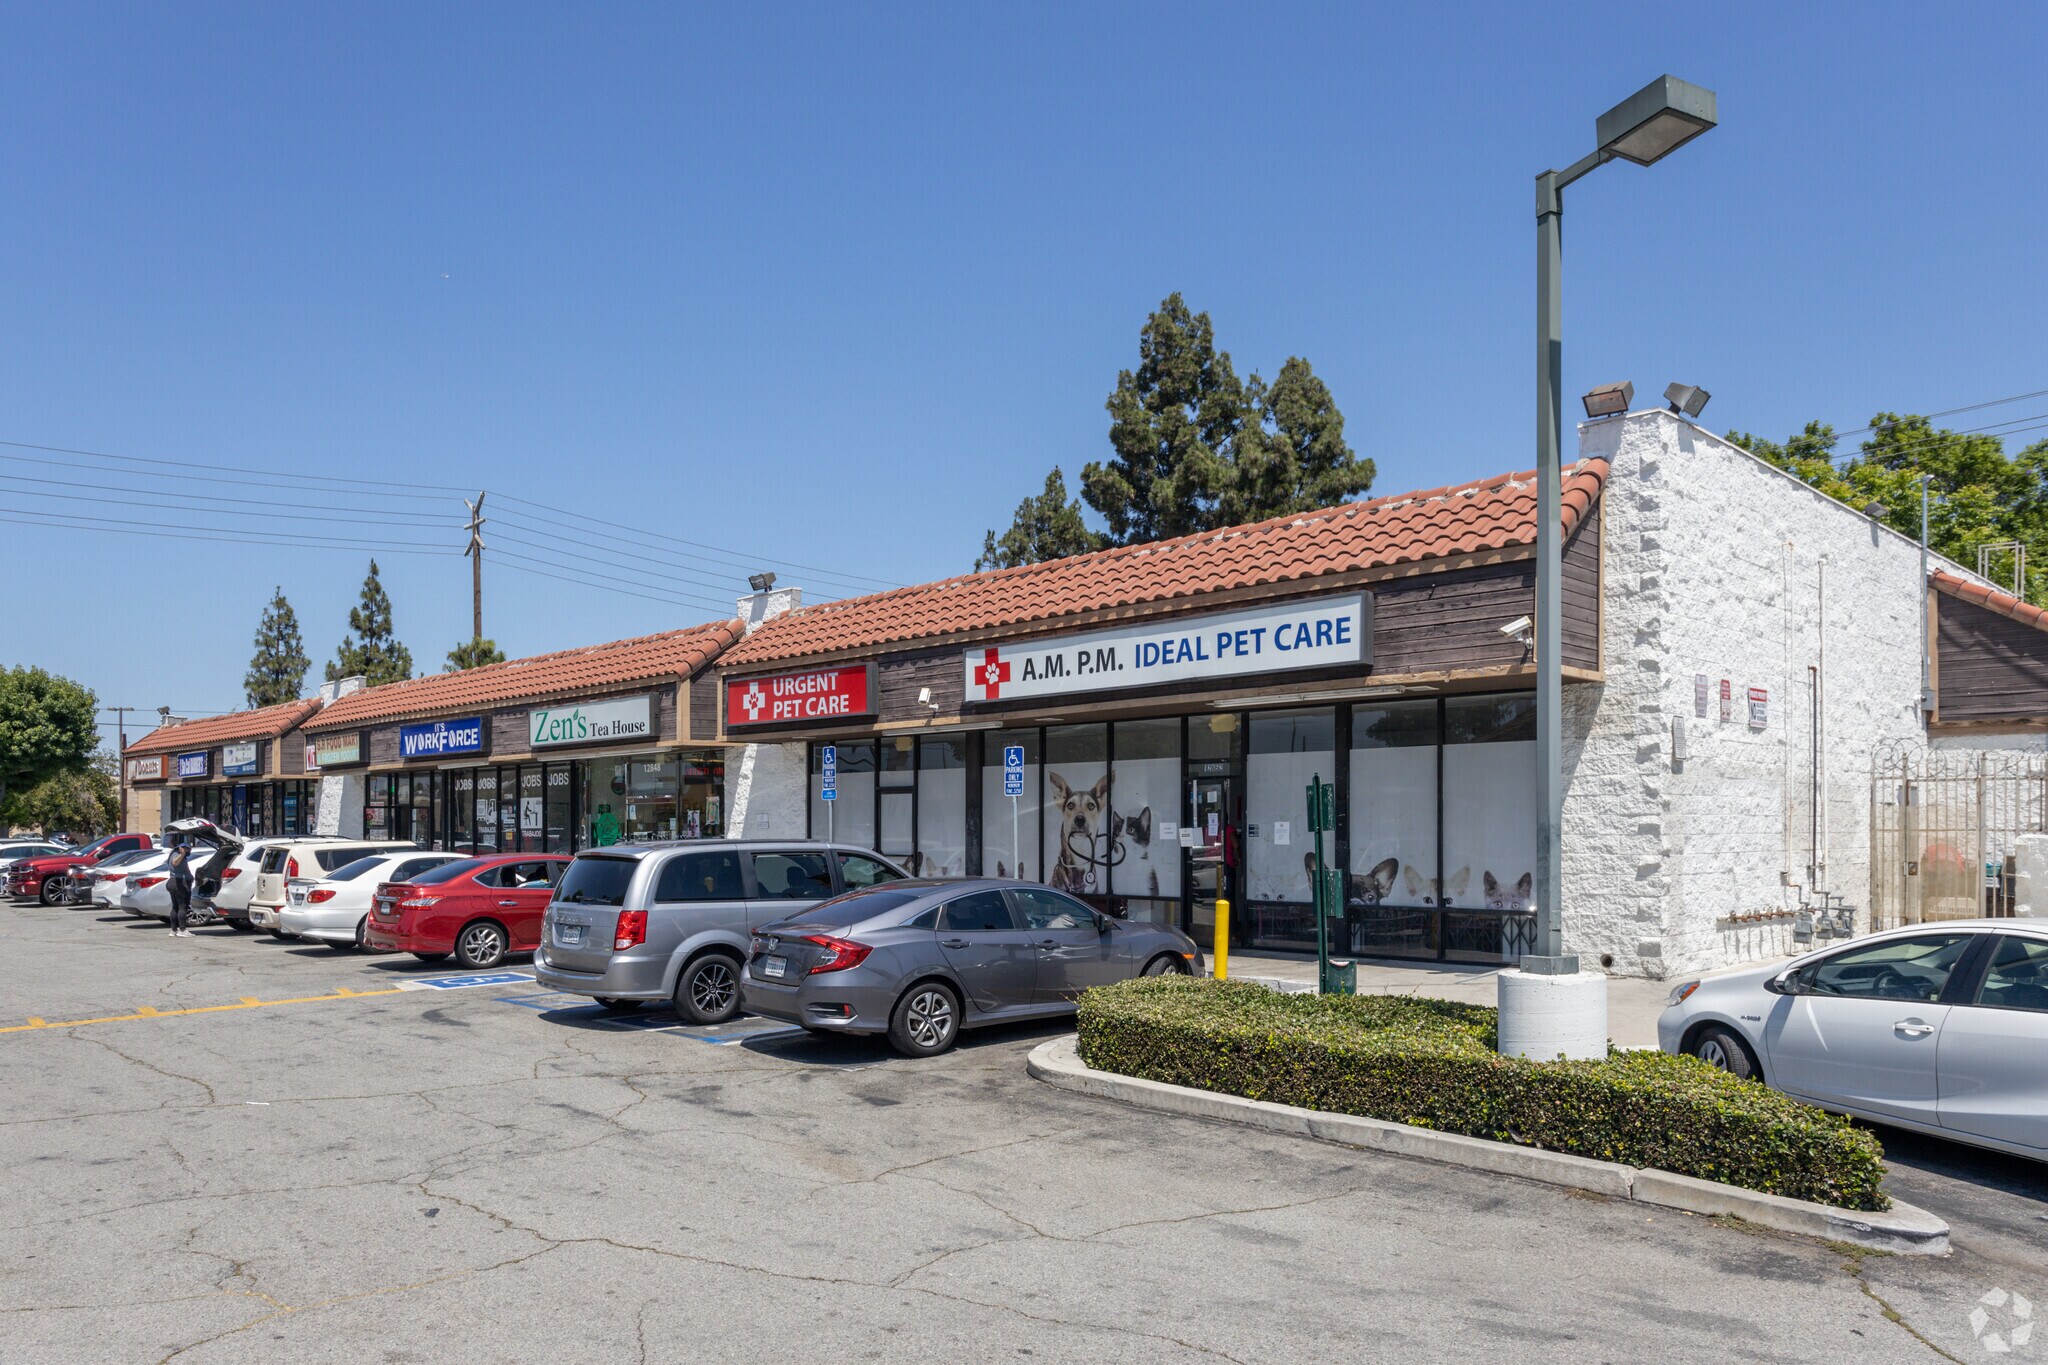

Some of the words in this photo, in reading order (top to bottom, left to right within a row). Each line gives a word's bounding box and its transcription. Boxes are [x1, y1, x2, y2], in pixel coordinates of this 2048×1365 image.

[1022, 653, 1071, 681] A.M.
[1078, 647, 1124, 675] P.M.
[1135, 636, 1209, 669] IDEAL
[1217, 628, 1266, 658] PET
[1274, 617, 1351, 651] CARE
[773, 672, 839, 697] URGENT
[773, 699, 802, 719] PET
[805, 694, 849, 716] CARE
[434, 722, 446, 733] IT'S
[535, 708, 587, 742] Zen's
[590, 723, 609, 737] Tea
[612, 720, 645, 734] House
[326, 736, 342, 750] FOOD
[342, 733, 359, 747] MART
[405, 728, 479, 754] WORKFORCE
[455, 779, 473, 790] JOBS
[477, 777, 496, 789] JOBS
[522, 774, 542, 787] JOBS
[548, 772, 569, 786] JOBS
[1008, 773, 1020, 781] ONLY
